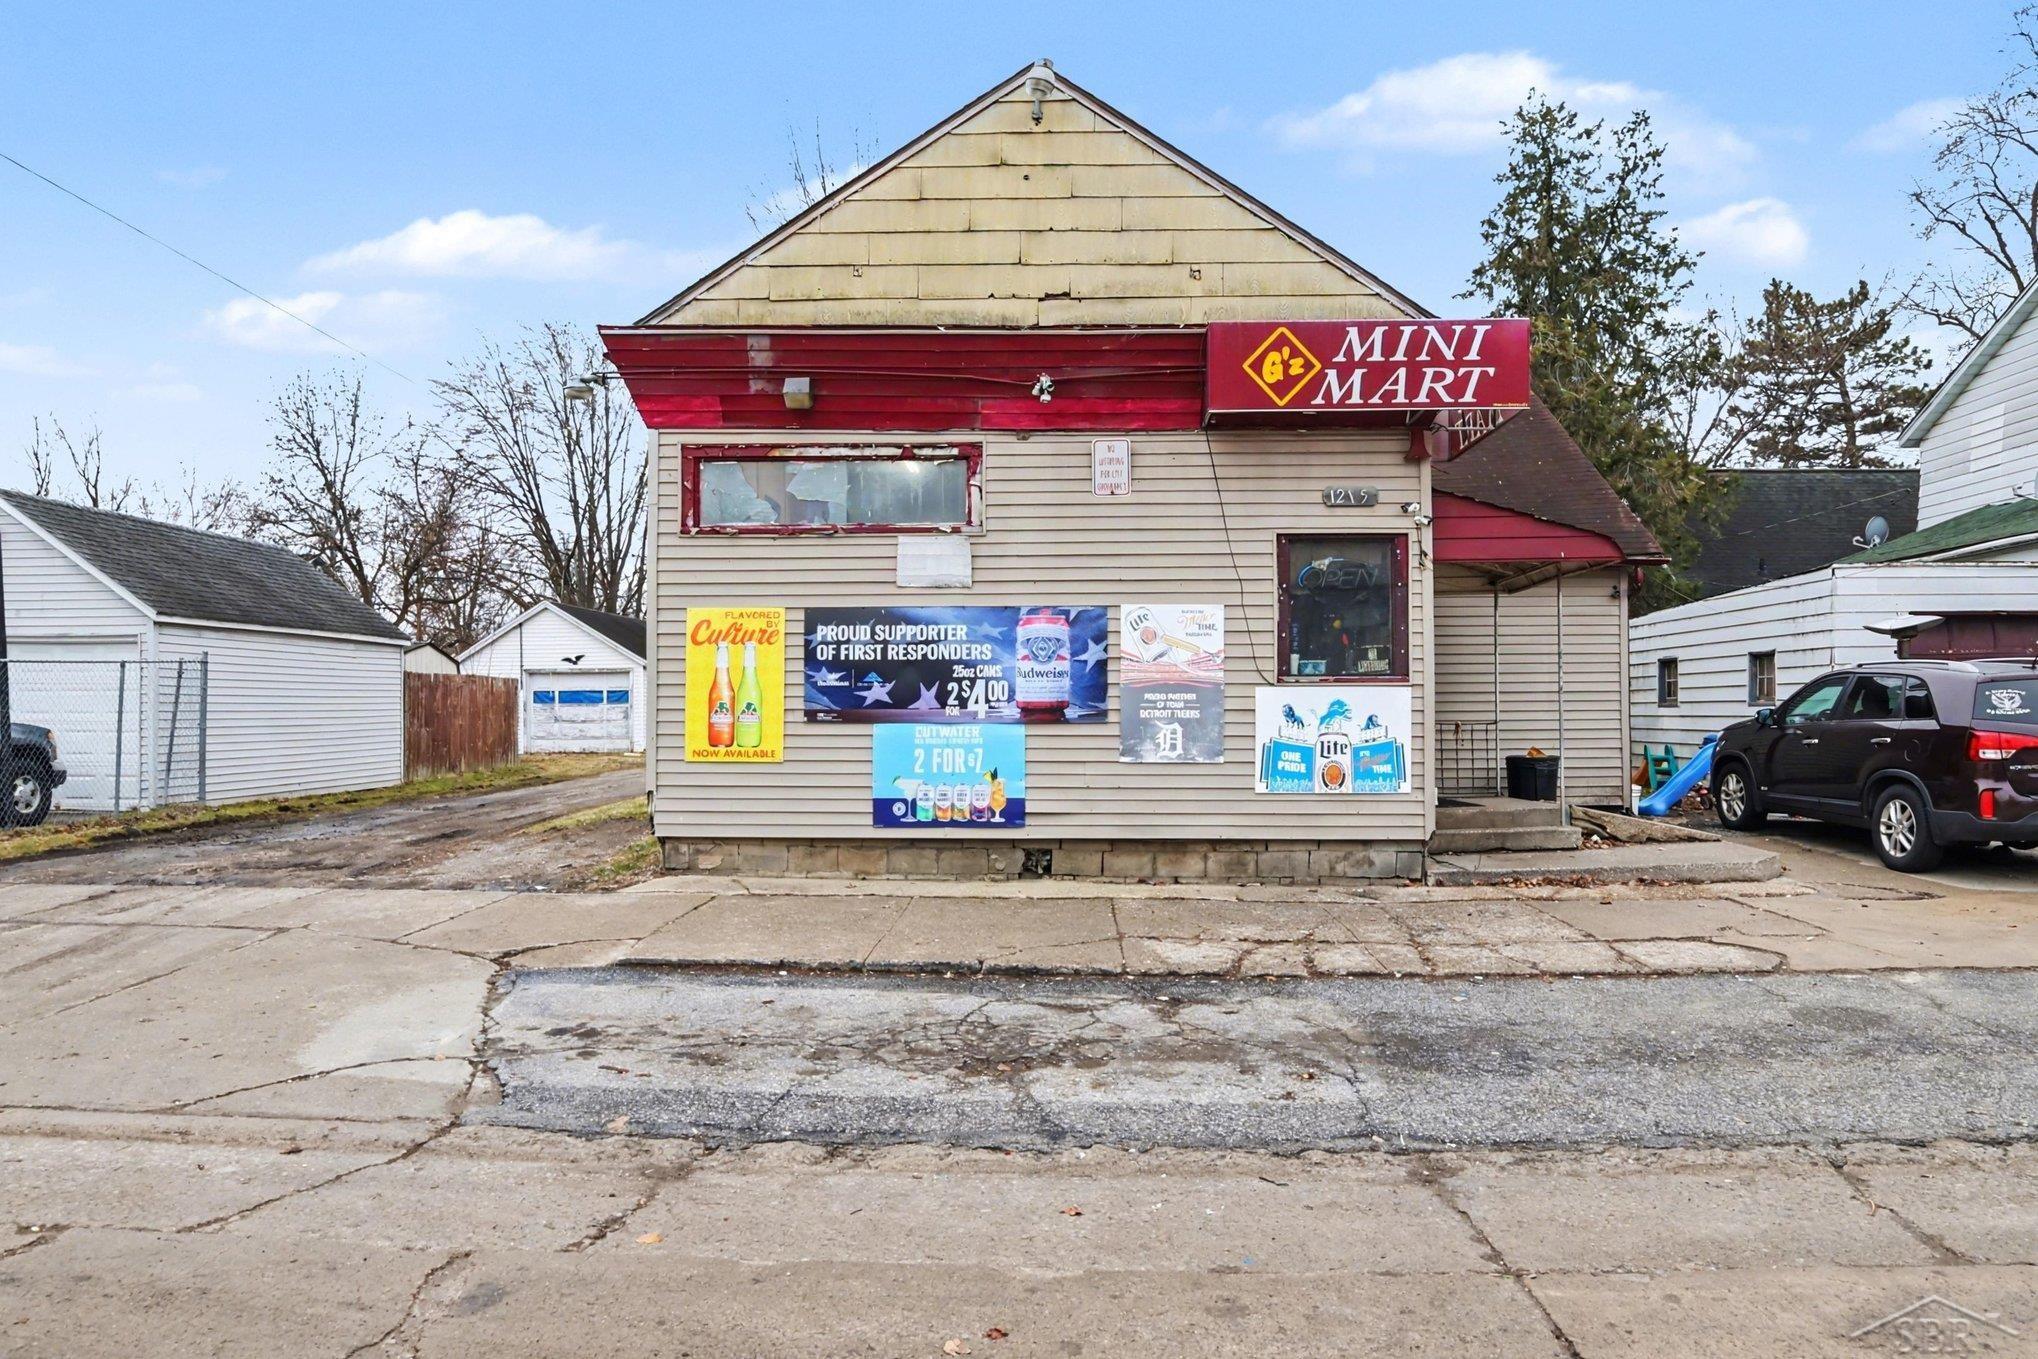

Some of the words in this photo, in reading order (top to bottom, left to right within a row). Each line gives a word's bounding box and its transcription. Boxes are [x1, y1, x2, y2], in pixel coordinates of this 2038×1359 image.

[1332, 325, 1492, 362] MINI
[1311, 366, 1496, 405] MART
[1303, 567, 1378, 589] OPEN
[724, 611, 781, 619] FLAVORED
[690, 619, 780, 646] Culture
[816, 625, 870, 641] PROUD
[874, 625, 967, 641] SUPPORTER
[816, 644, 838, 661] OF
[840, 644, 883, 661] FIRST
[887, 644, 992, 661] RESPONDERS
[952, 665, 975, 678] 25oz
[976, 665, 1003, 678] CANS
[947, 682, 959, 705] 2
[945, 706, 960, 716] FOR
[915, 726, 981, 738] CUTWATER
[692, 749, 720, 758] NOW
[723, 749, 776, 758] AVAILABLE
[1280, 750, 1302, 762] ONE
[1319, 741, 1348, 759] Lite
[914, 748, 925, 774] 2
[932, 748, 967, 774] FOR
[1277, 761, 1307, 774] PRIDE
